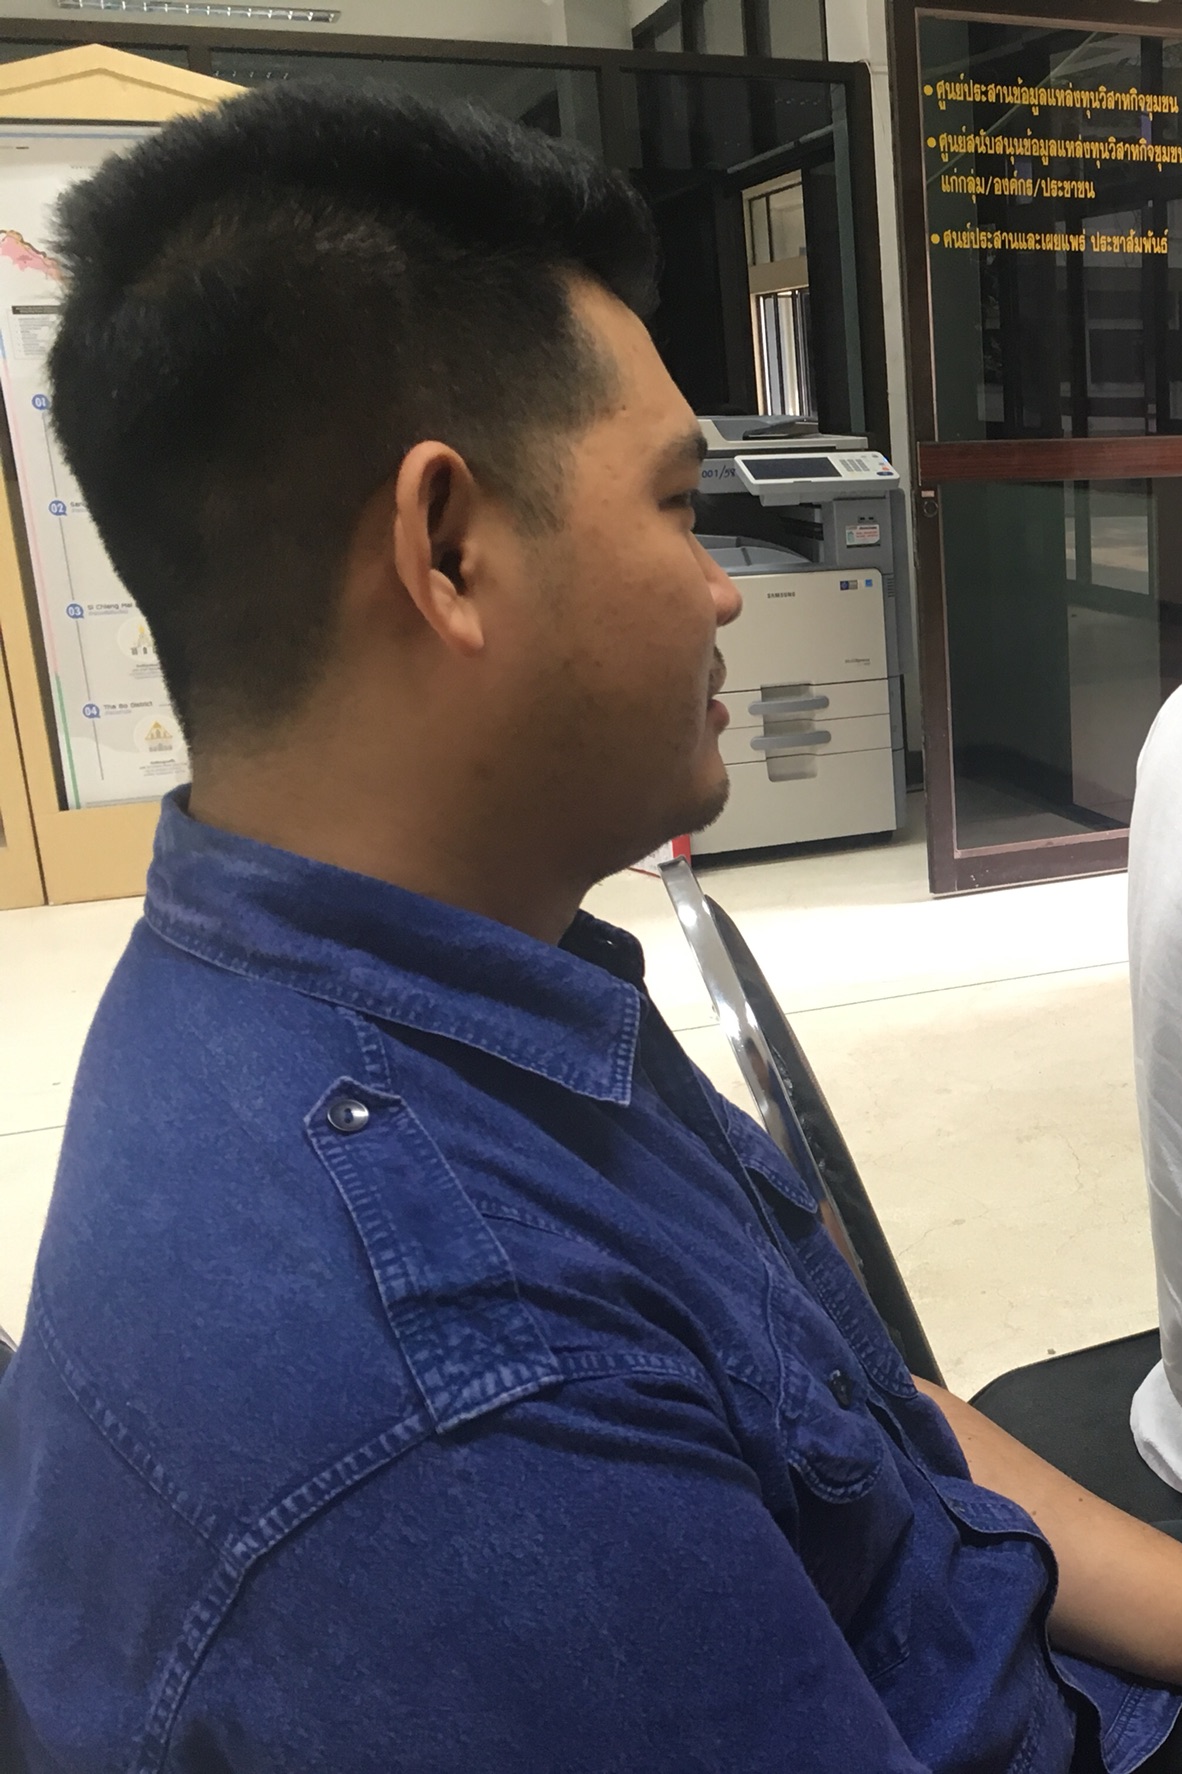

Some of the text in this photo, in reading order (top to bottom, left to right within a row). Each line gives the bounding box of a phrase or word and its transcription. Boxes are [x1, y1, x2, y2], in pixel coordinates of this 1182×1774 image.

[35, 397, 46, 407] 01
[51, 503, 64, 513] 02
[767, 591, 796, 599] SAMSUNG
[69, 606, 81, 616] 03
[85, 706, 97, 716] 04
